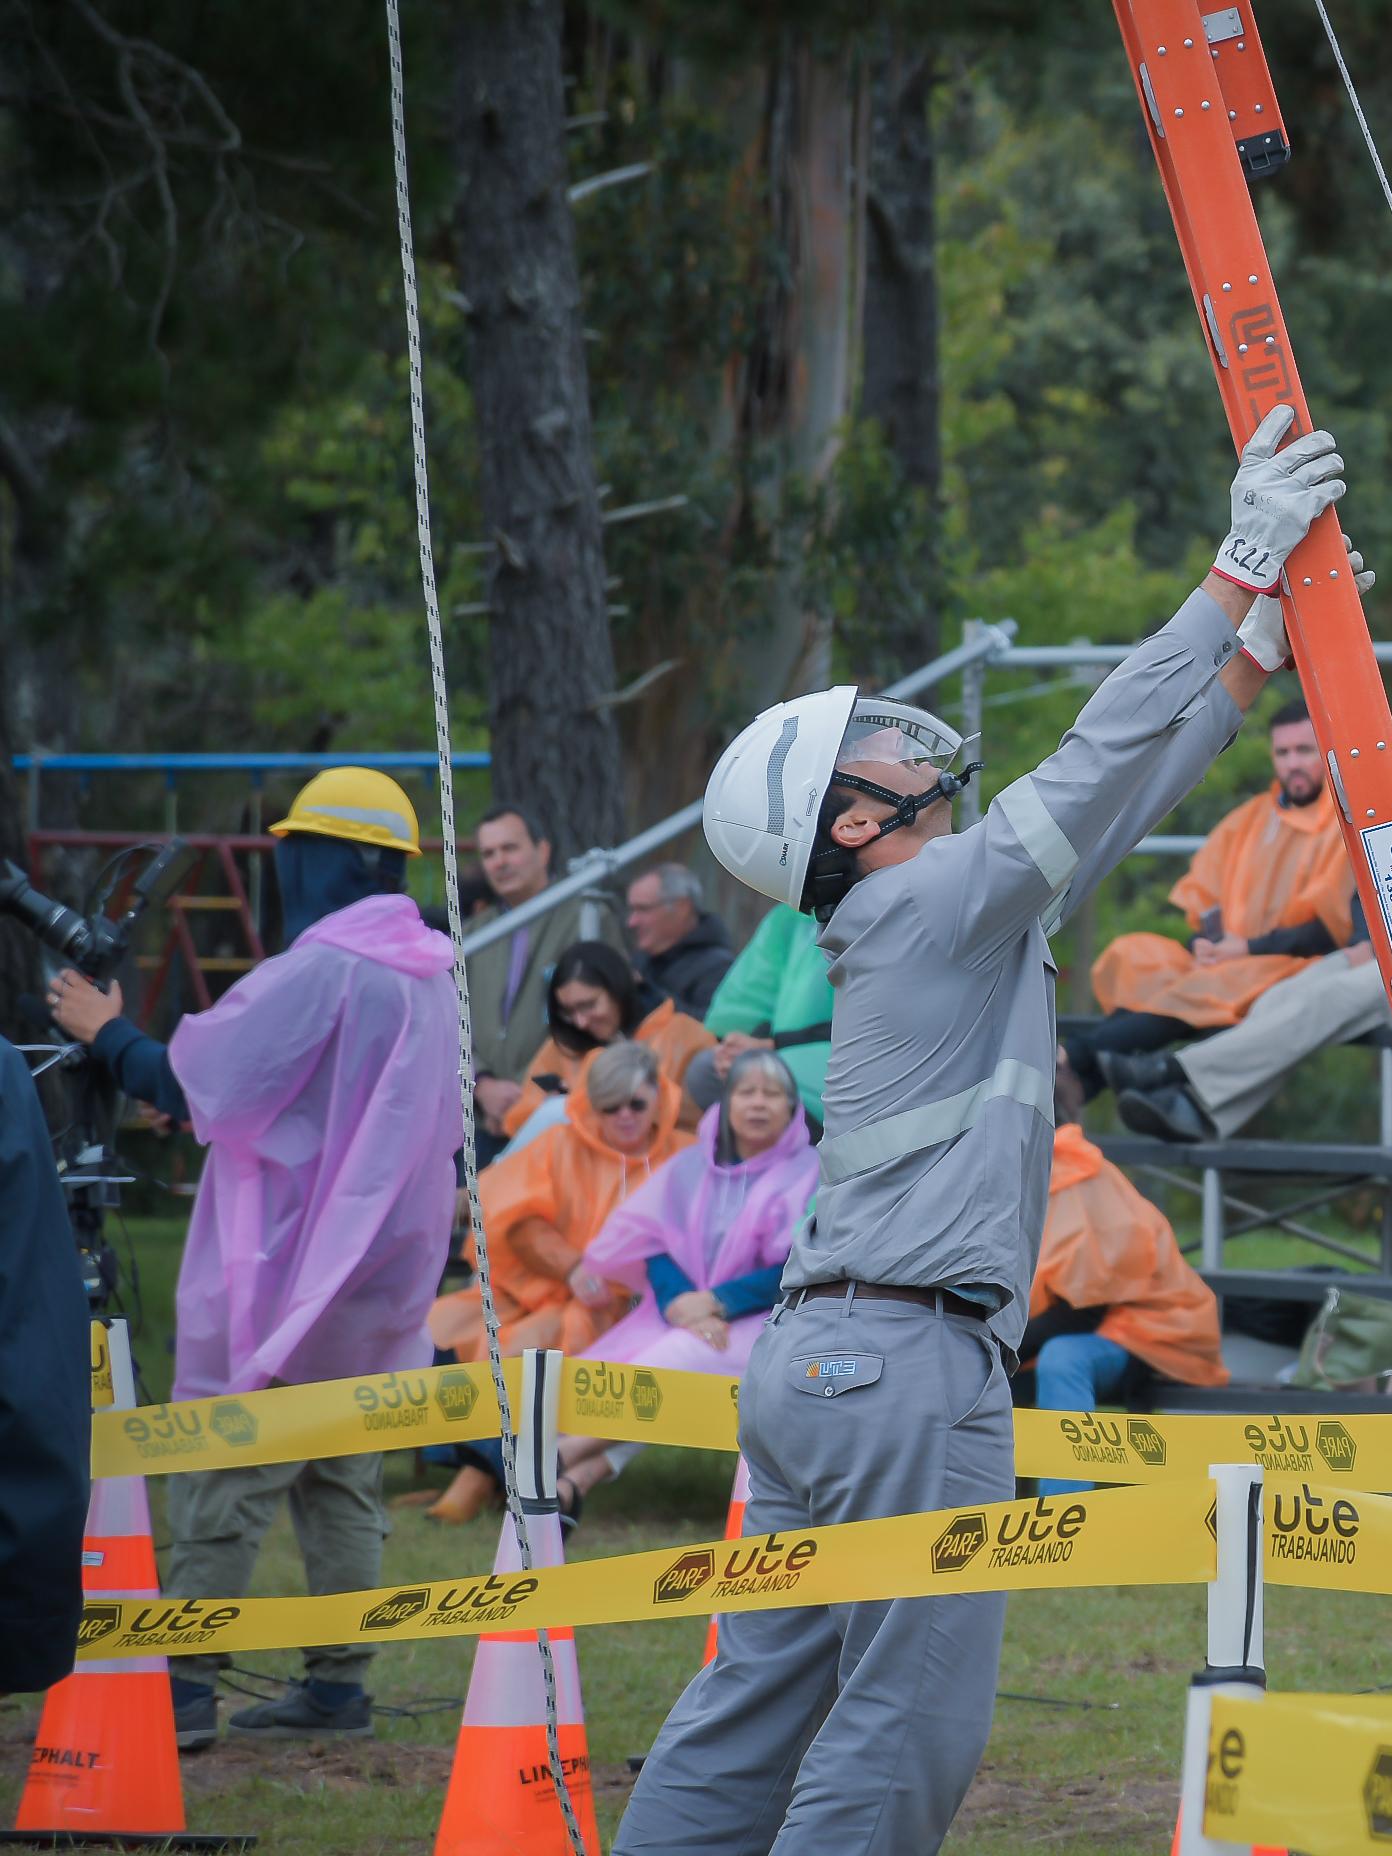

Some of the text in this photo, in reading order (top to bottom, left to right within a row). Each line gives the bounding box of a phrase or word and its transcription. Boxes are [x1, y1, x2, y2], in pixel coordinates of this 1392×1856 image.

[1230, 303, 1302, 440] UT
[819, 1360, 856, 1377] UTE
[998, 1496, 1086, 1545] ute
[1274, 1483, 1359, 1537] ute
[724, 1534, 818, 1579] ute
[937, 1530, 982, 1558] PARE
[988, 1540, 1073, 1568] TRABAJANDO
[1271, 1534, 1356, 1565] TRABAJANDO
[437, 1575, 539, 1611] ute
[660, 1566, 709, 1592] PARE
[710, 1572, 800, 1598] TRABAJANDO
[130, 1600, 241, 1632] ute
[368, 1601, 422, 1622] PARE
[420, 1605, 517, 1627] TRABAJANDO
[78, 1618, 114, 1639] ARE
[112, 1630, 217, 1648] TRABAJANDO
